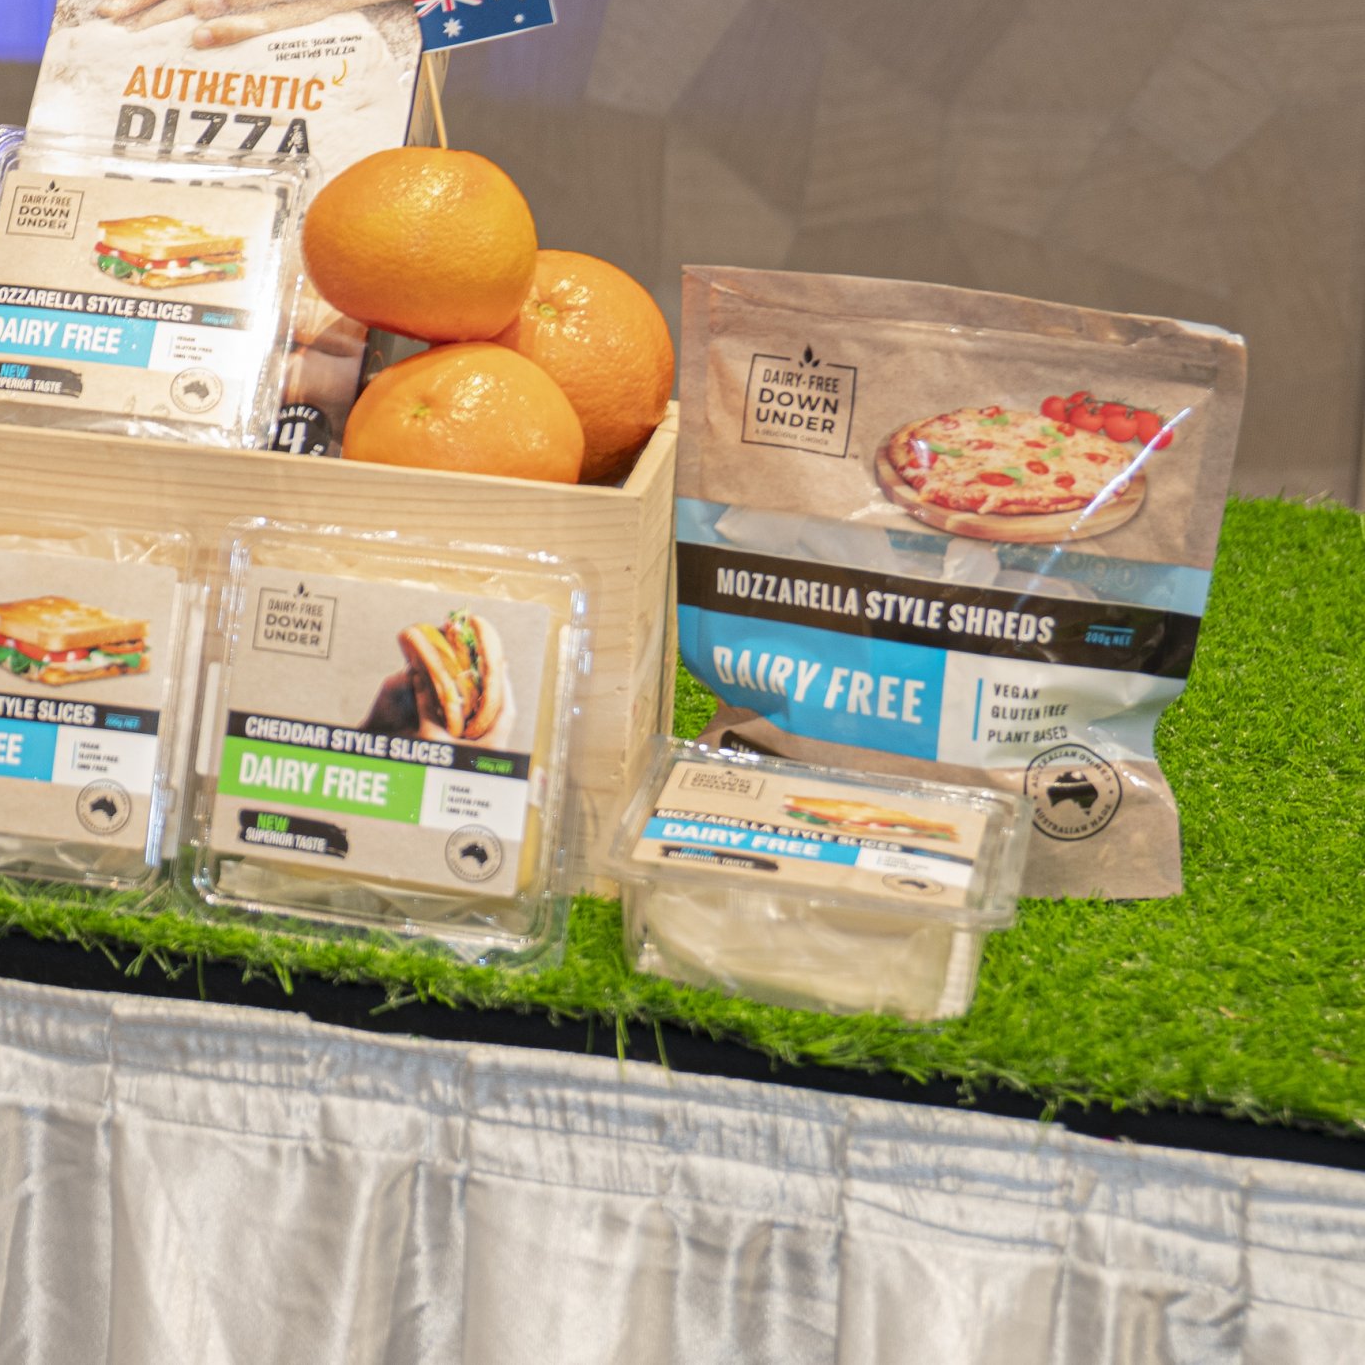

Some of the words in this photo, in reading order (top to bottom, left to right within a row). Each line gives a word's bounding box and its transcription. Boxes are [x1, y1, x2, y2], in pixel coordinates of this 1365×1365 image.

[123, 65, 325, 111] AUTHENTIC
[17, 217, 67, 230] UNDER
[19, 205, 70, 218] DOWN
[86, 295, 135, 316] STYLE
[137, 301, 194, 322] SLICES
[61, 323, 123, 354] FREE
[0, 362, 30, 378] NEW
[762, 368, 840, 394] DAIRY-FREE
[34, 379, 63, 394] TASTE
[758, 387, 839, 414] DOWN
[756, 407, 835, 434] UNDER
[279, 422, 306, 453] 4
[716, 567, 860, 616] MOZZARELLA
[865, 590, 942, 630] STYLE
[947, 603, 1056, 644] SHREDS
[266, 613, 322, 632] DOWN
[264, 629, 320, 646] UNDER
[712, 645, 822, 703] DAIRY
[824, 666, 926, 724] FREE
[993, 683, 1038, 700] VEGAN
[37, 700, 96, 726] SLICES
[991, 705, 1040, 721] GLUTEN
[1043, 703, 1069, 719] FREE
[245, 715, 330, 749] CHEDDAR
[331, 728, 388, 757] STYLE
[389, 737, 454, 766] SLICES
[987, 729, 1030, 743] PLANT
[1033, 725, 1068, 743] BASED
[239, 751, 318, 794] DAIRY
[322, 765, 390, 806] FREE
[256, 812, 290, 832] NEW
[656, 809, 774, 832] MOZZARELLA
[777, 825, 834, 842] STYLE
[836, 835, 902, 852] SLICES
[245, 827, 294, 848] SUPERIOR
[295, 834, 327, 853] TASTE
[662, 823, 747, 846] DAIRY
[751, 835, 822, 858] FREE
